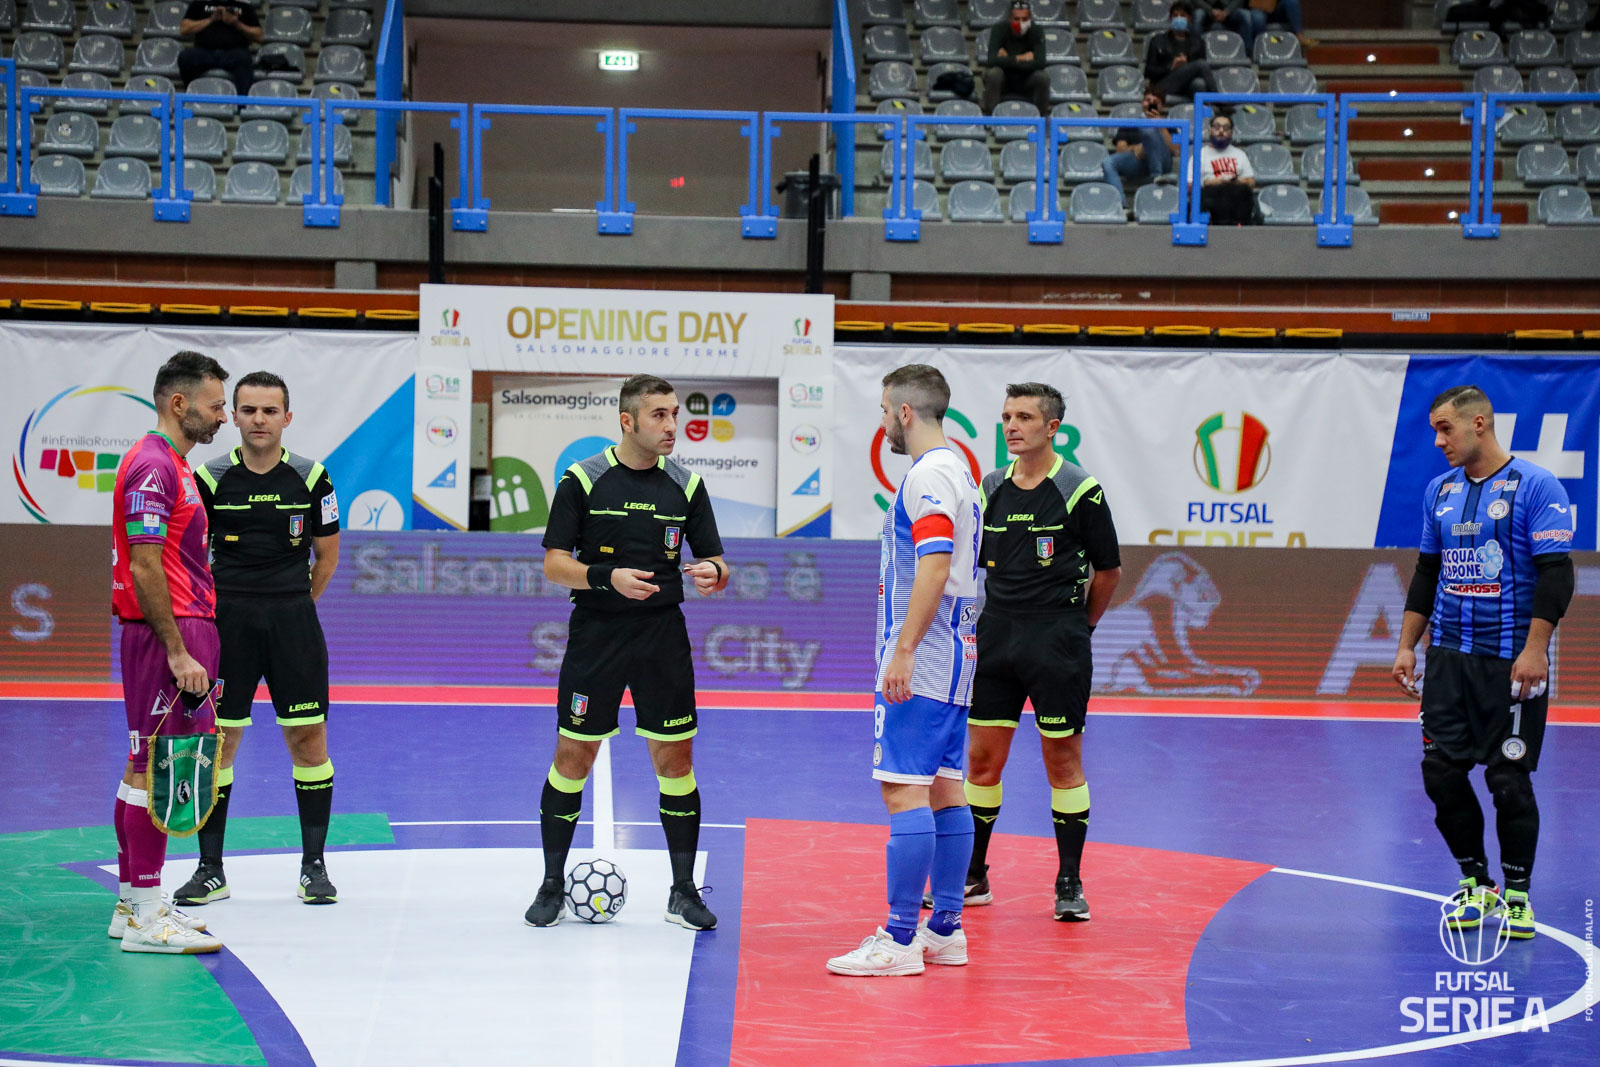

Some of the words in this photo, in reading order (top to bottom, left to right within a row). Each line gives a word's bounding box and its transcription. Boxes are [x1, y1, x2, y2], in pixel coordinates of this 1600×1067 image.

[507, 306, 668, 342] OPENING
[678, 311, 748, 344] DAY
[516, 344, 670, 357] SALSOMAGGIORE
[684, 348, 739, 358] TERME
[501, 389, 619, 410] Salsomaggiore
[248, 494, 281, 502] LEGEA
[623, 502, 657, 511] LEGEA
[1187, 502, 1274, 524] FUTSAL
[1006, 513, 1035, 522] LEGEA
[1442, 549, 1475, 564] ACQUA
[706, 624, 820, 689] City
[289, 701, 320, 713] LEGEA
[663, 714, 693, 728] LEGEA
[875, 704, 886, 739] 8
[1040, 716, 1067, 724] LEGEA
[1509, 703, 1522, 735] 1
